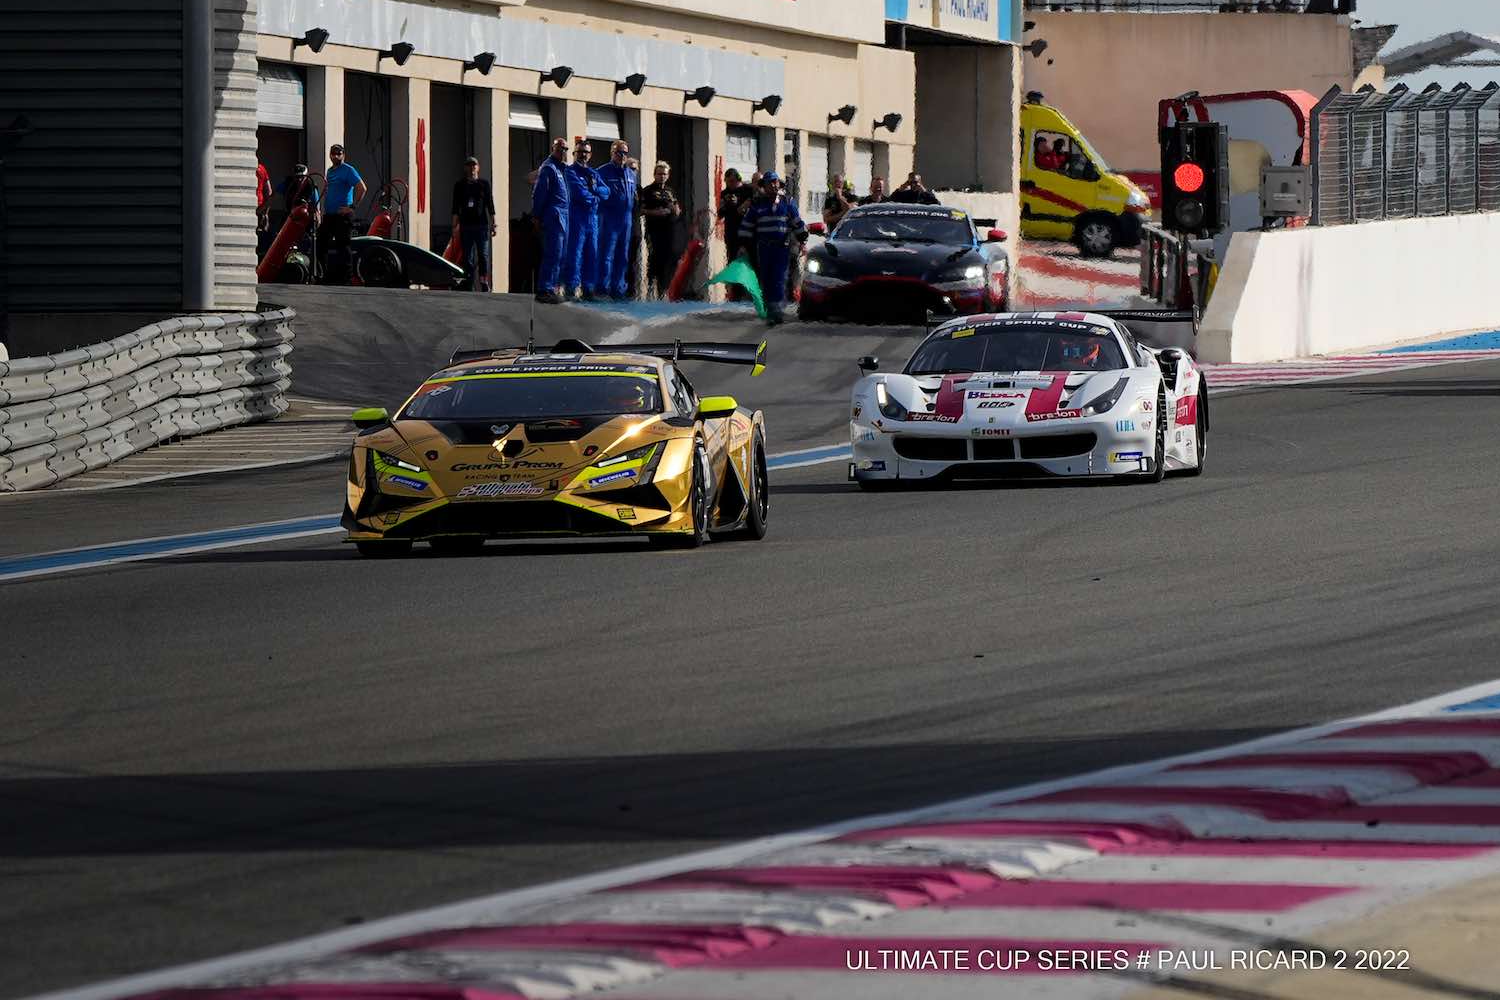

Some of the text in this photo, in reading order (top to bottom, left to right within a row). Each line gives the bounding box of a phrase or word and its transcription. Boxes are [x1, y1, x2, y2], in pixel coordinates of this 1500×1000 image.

[957, 320, 1001, 332] HYPER
[1059, 321, 1088, 329] CUP
[475, 367, 520, 375] COUPE
[523, 365, 567, 373] HYPER
